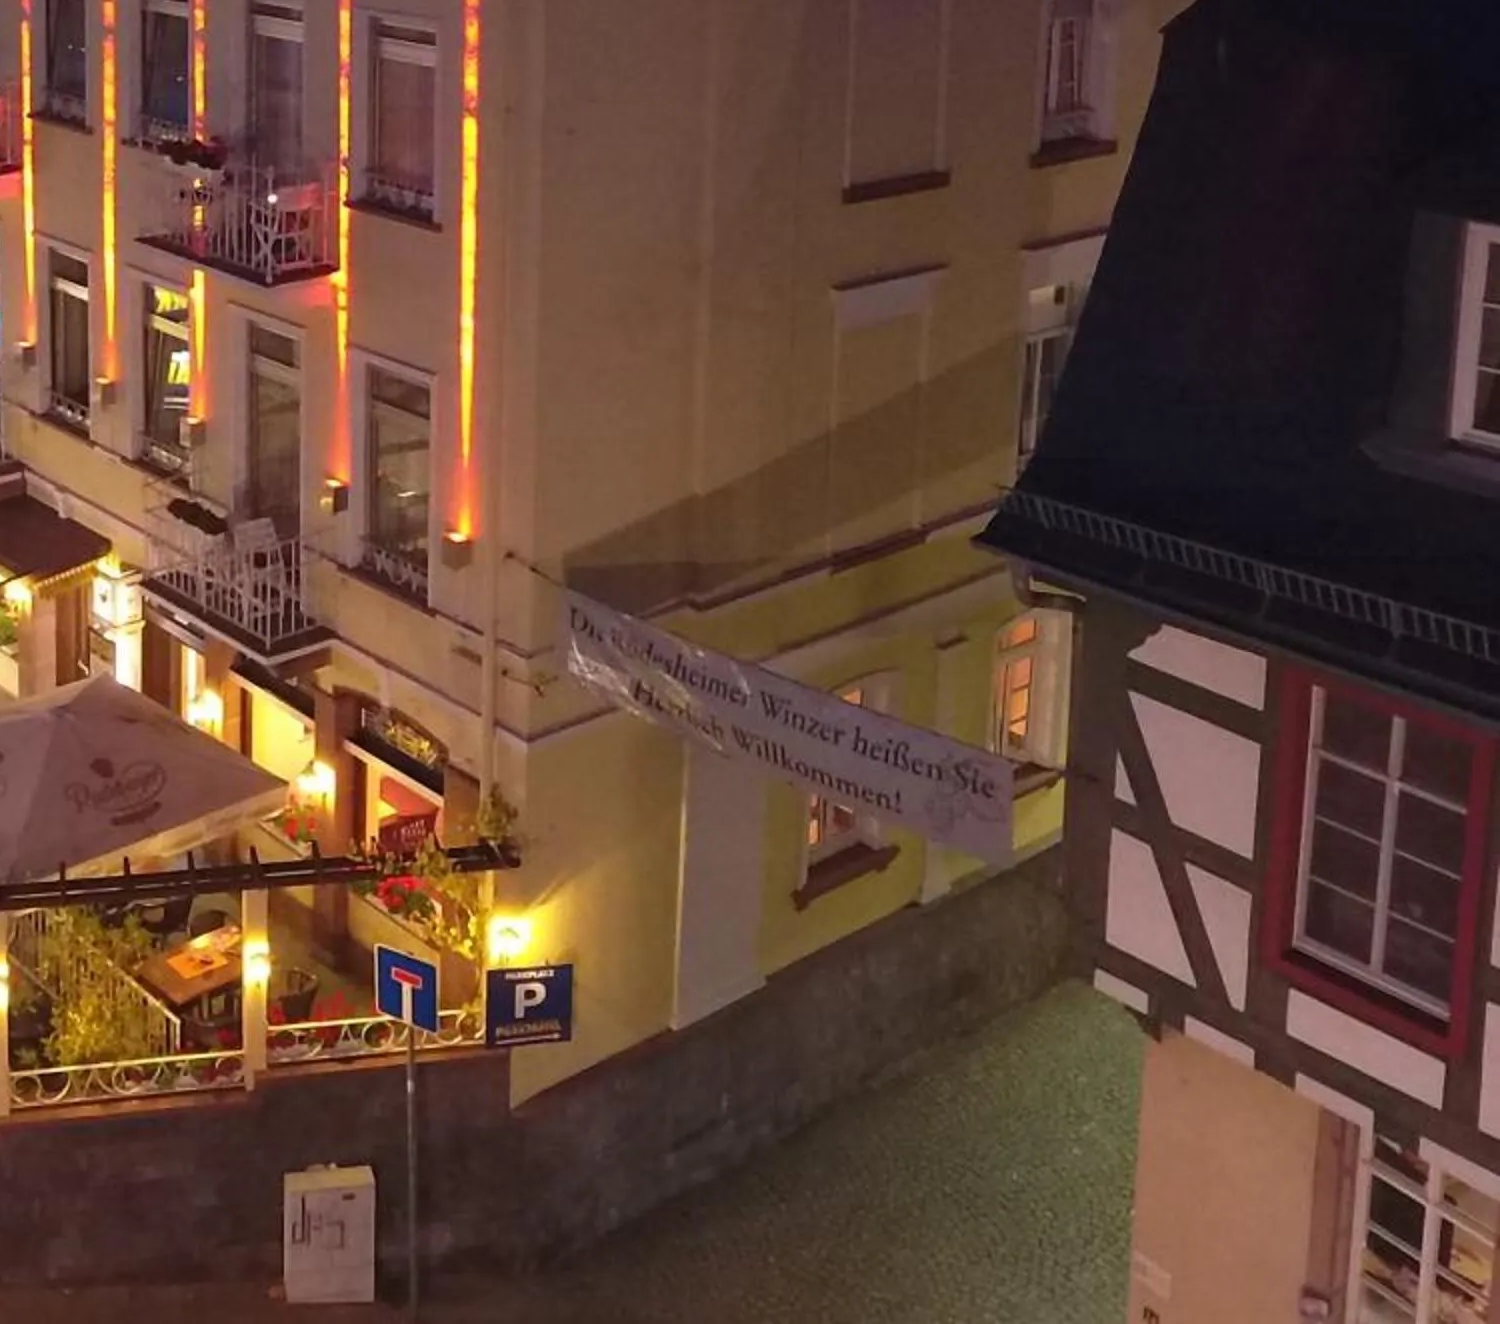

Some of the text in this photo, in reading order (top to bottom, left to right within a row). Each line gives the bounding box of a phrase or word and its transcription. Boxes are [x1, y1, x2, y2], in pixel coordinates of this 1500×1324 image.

[610, 624, 751, 707] desheimer
[760, 689, 847, 748] Winzer
[853, 725, 945, 782] heißen
[953, 760, 997, 800] Sie
[632, 679, 904, 815] Helich Willkommen!
[514, 982, 547, 1019] P
